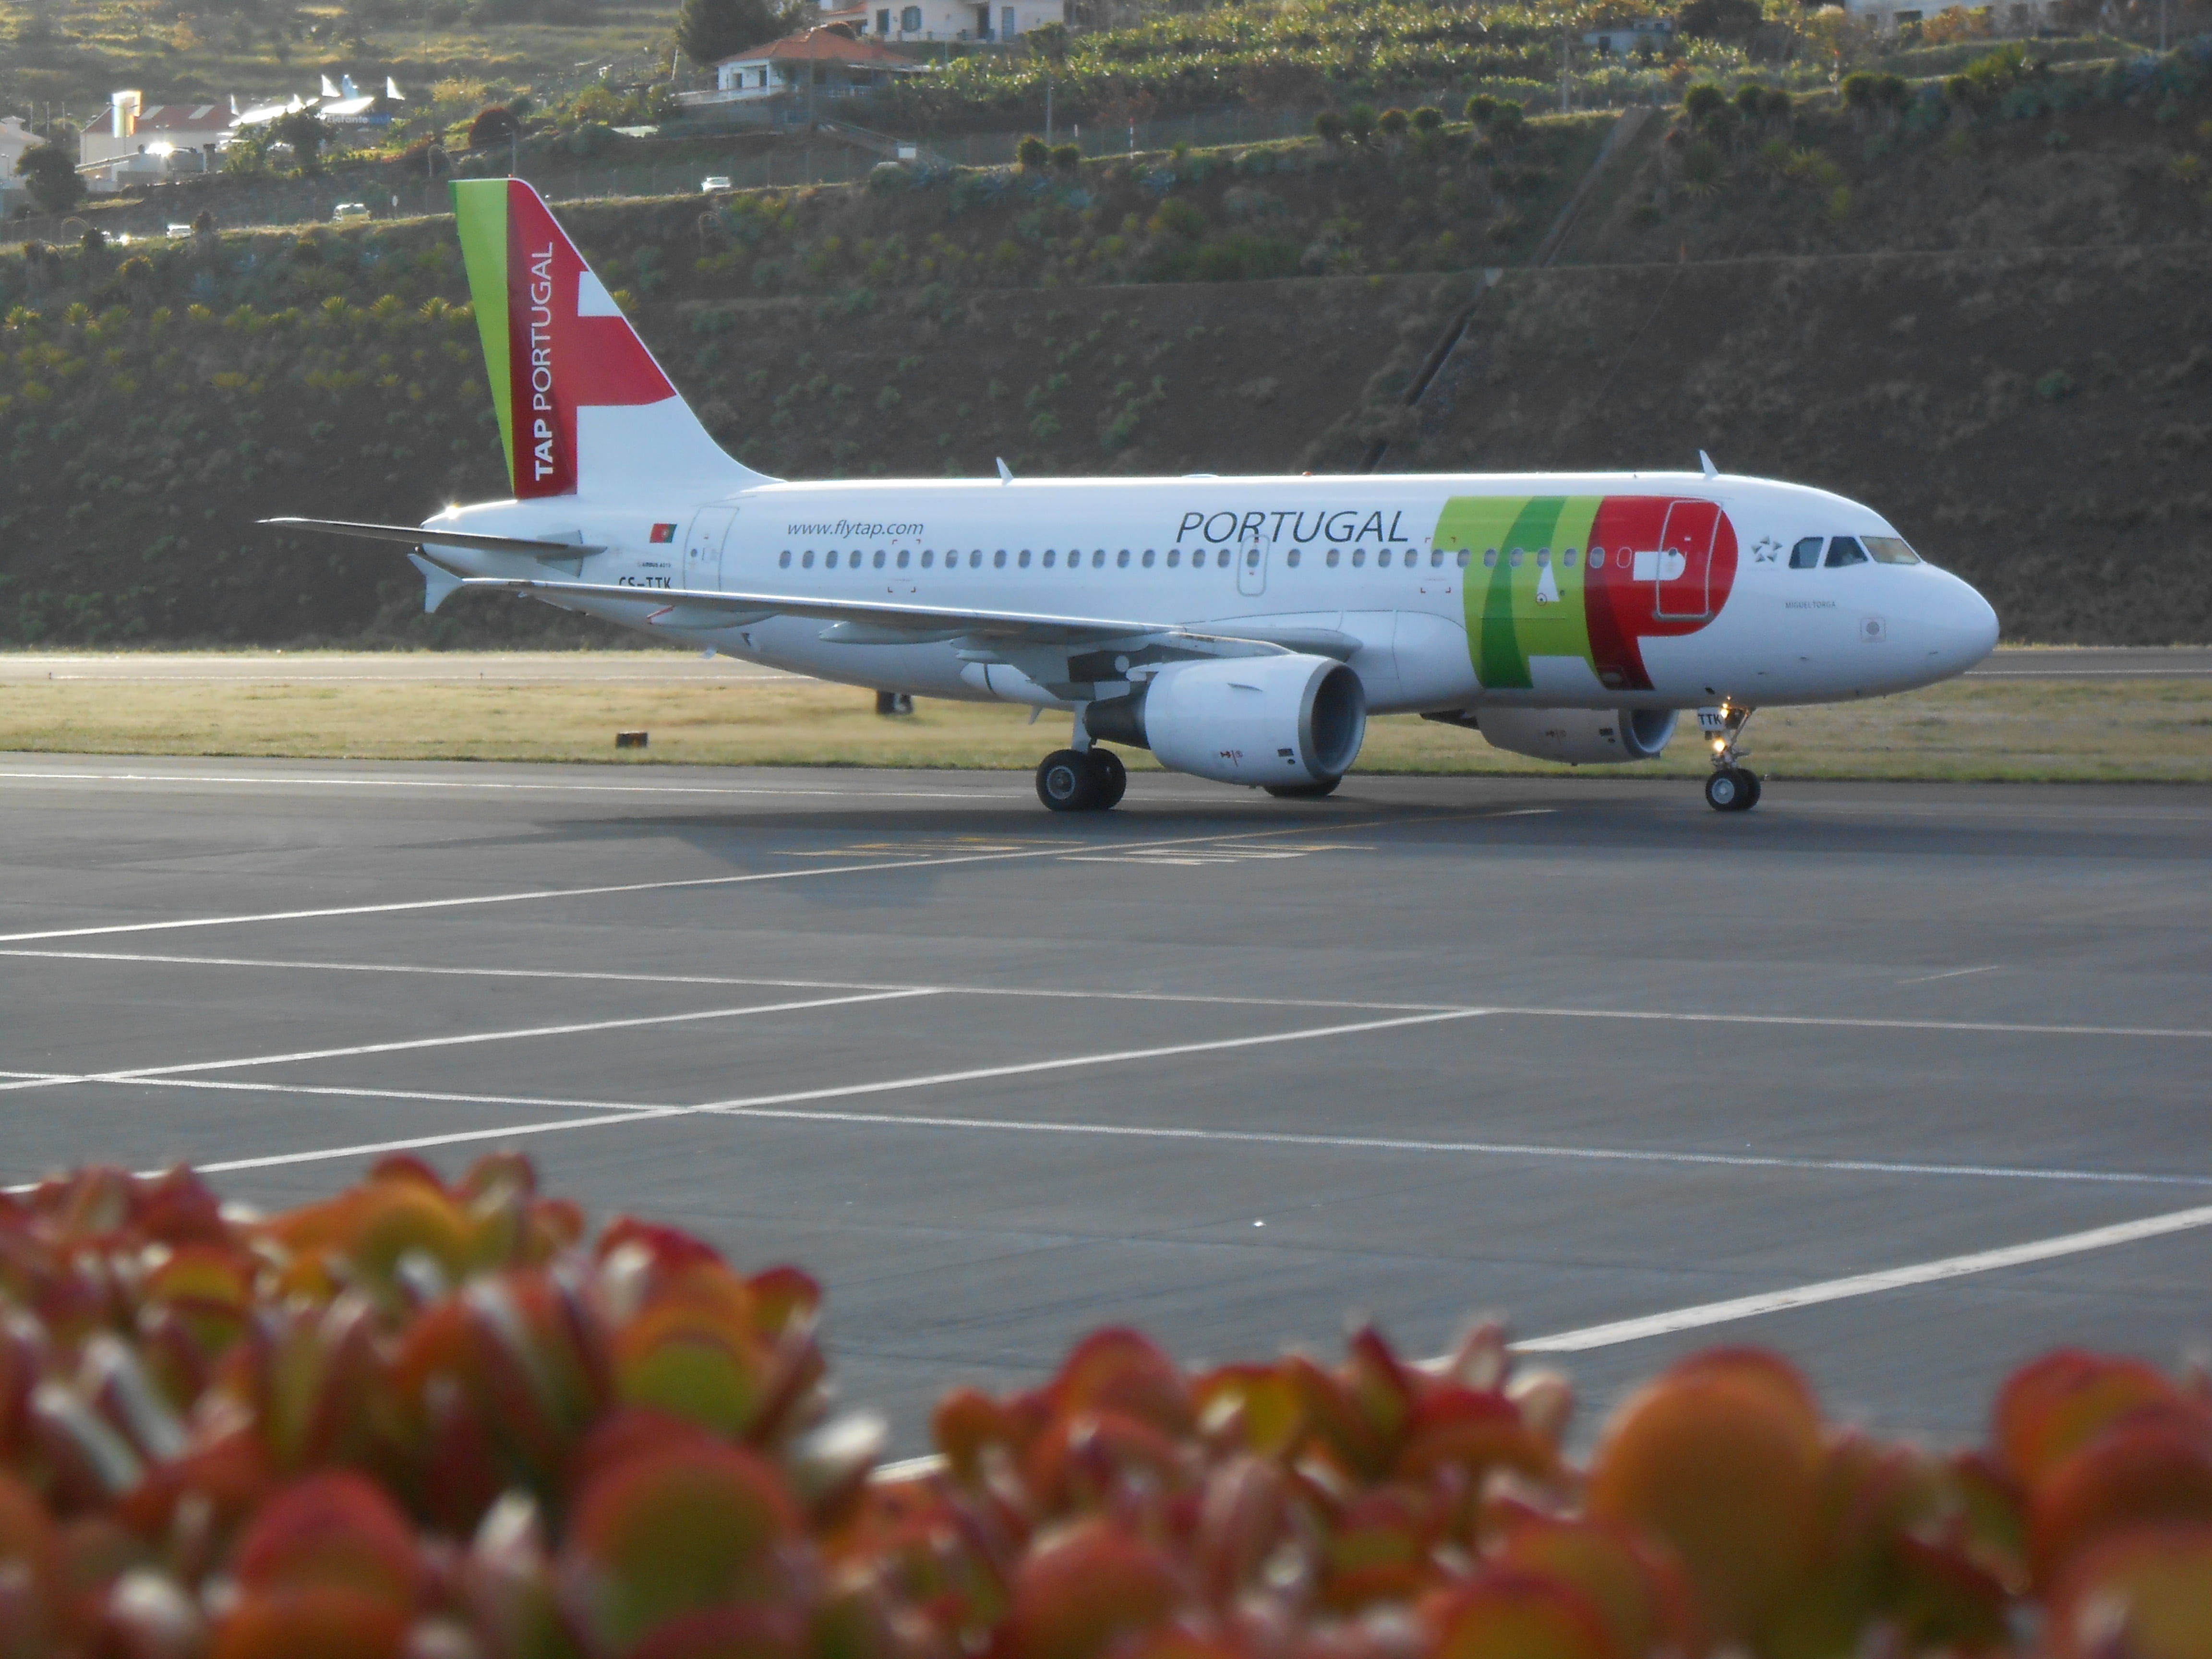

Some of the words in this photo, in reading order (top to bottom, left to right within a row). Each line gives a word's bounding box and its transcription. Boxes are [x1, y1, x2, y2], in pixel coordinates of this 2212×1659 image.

[531, 241, 553, 411] PORTUGAL
[534, 418, 553, 481] TAP
[787, 519, 924, 539] www.flytap.com
[1176, 510, 1408, 543] PORTUGAL
[1698, 714, 1722, 725] TTK
